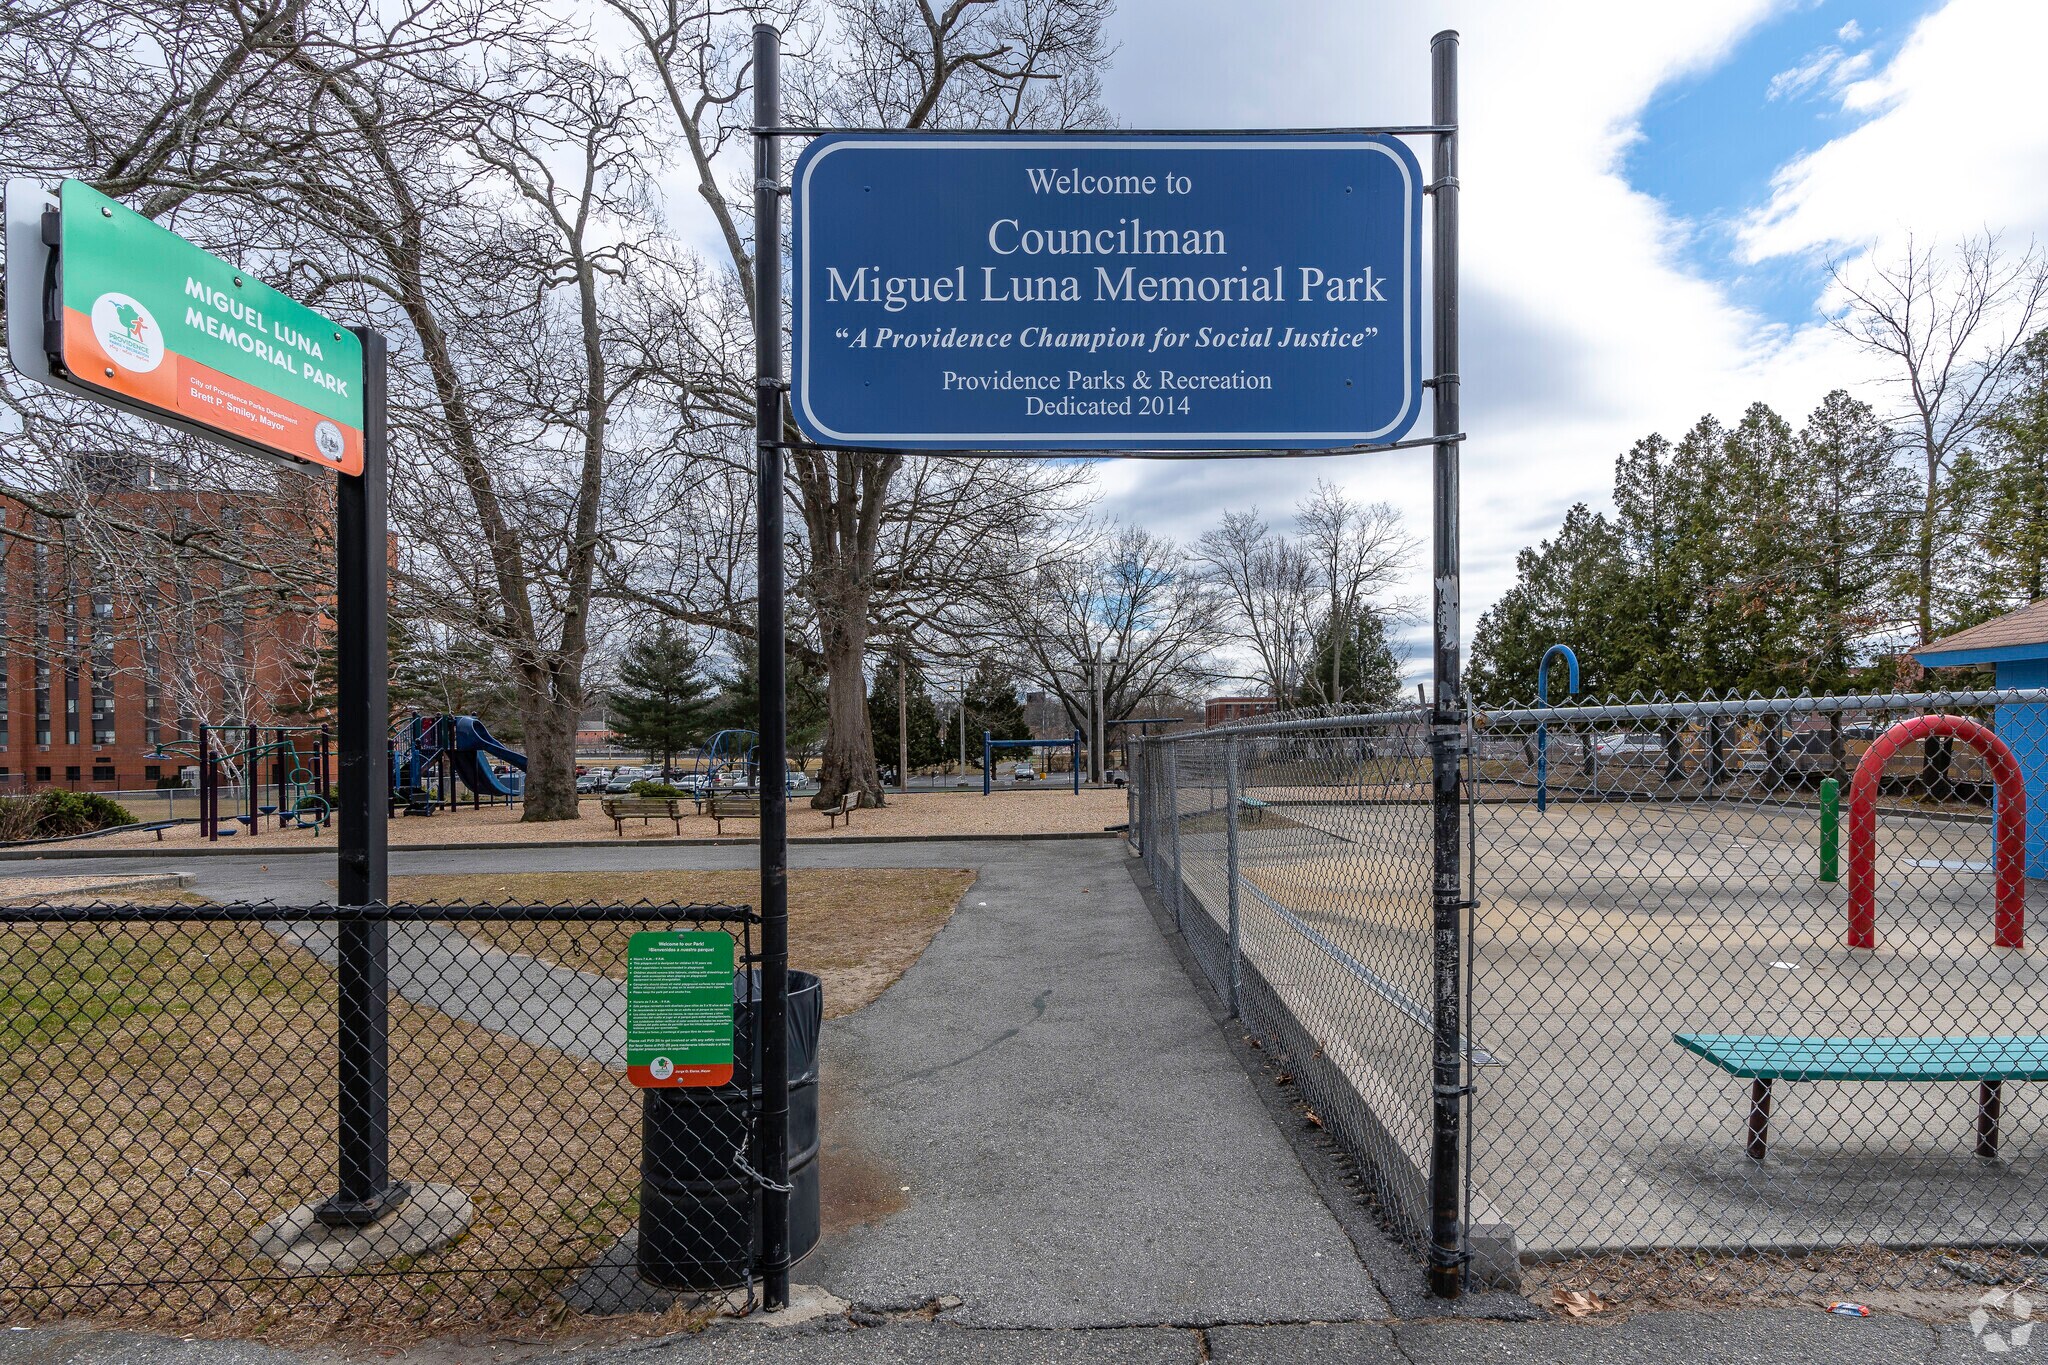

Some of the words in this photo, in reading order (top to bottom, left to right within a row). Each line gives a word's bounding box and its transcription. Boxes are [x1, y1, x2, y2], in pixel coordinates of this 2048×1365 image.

[1026, 168, 1156, 194] Welcome
[1166, 171, 1193, 194] to
[989, 218, 1227, 255] Councilman
[826, 266, 967, 313] Miguel
[981, 266, 1081, 302] Luna
[1094, 266, 1285, 302] Memorial
[1299, 266, 1387, 302] Park
[185, 276, 268, 334] MIGUEL
[274, 321, 324, 361] LUNA
[109, 333, 149, 354] PROVIDENCE
[185, 307, 297, 374] MEMORIAL
[303, 362, 348, 398] PARK
[873, 327, 1012, 349] Providence
[1020, 327, 1145, 353] Champion
[1149, 327, 1190, 354] for
[1195, 327, 1273, 348] Social
[943, 370, 1060, 391] Providence
[1068, 370, 1125, 390] Parks
[1133, 370, 1152, 390] &
[1160, 370, 1272, 390] Recreation
[190, 377, 203, 388] City
[213, 387, 248, 405] Providence
[248, 400, 265, 412] Parks
[266, 407, 298, 425] Department
[190, 388, 214, 404] Brett
[216, 397, 224, 408] P.
[226, 402, 258, 422] Smiley,
[259, 414, 285, 432] Mayor
[1025, 396, 1132, 416] Dedicated
[1139, 396, 1191, 416] 2014
